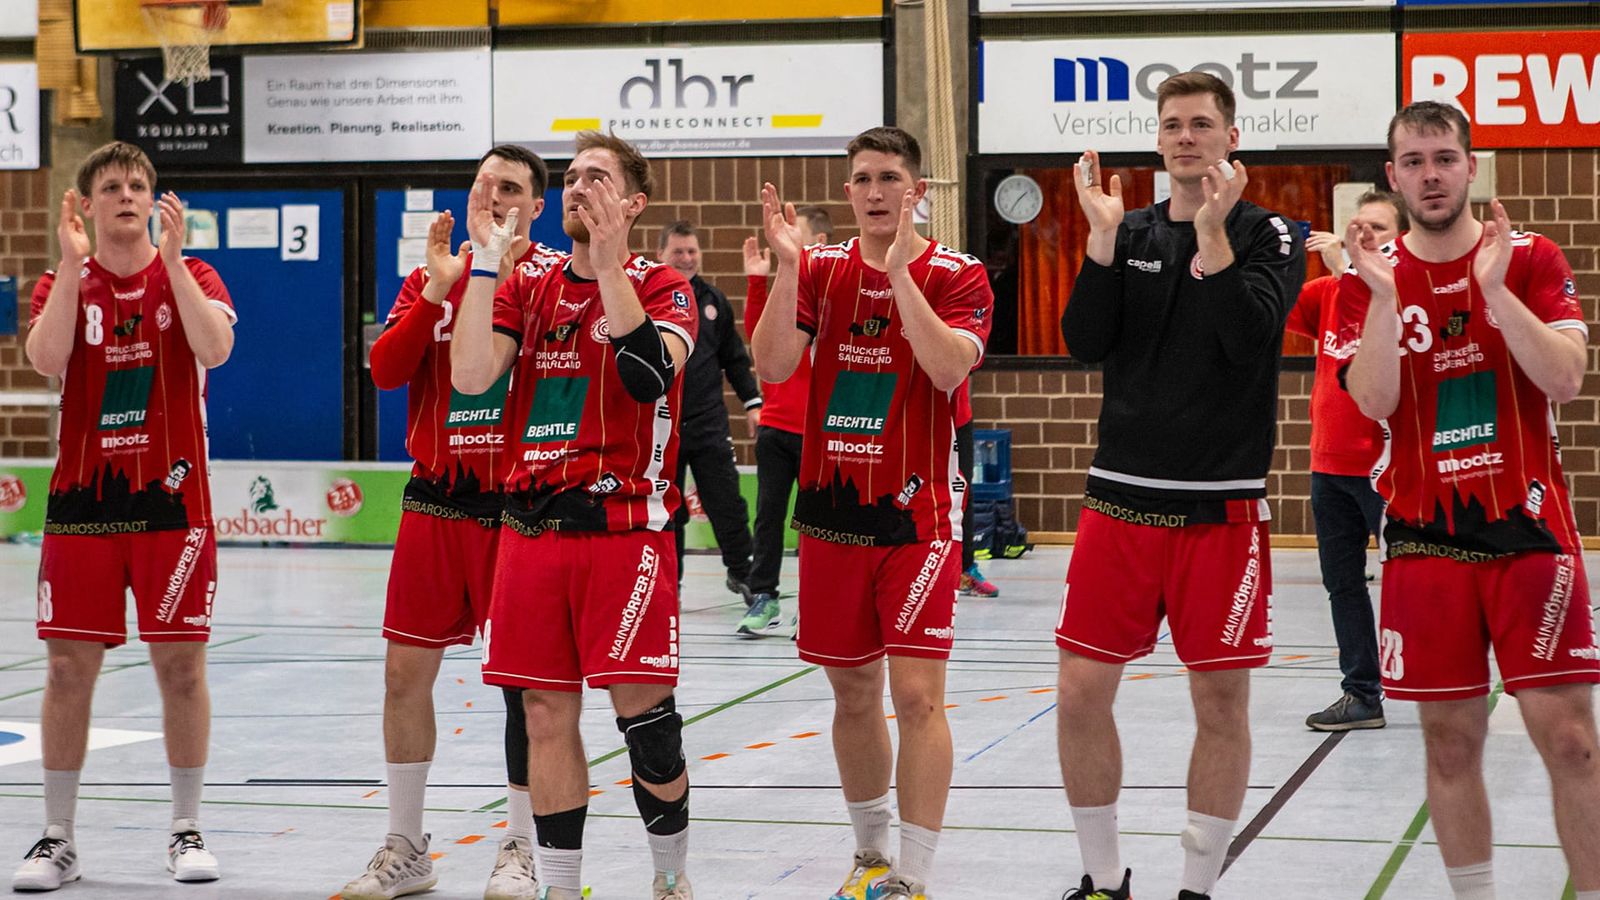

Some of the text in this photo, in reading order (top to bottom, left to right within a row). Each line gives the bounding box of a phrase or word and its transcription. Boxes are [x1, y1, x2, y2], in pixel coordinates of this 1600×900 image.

[267, 80, 286, 92] Ein
[290, 79, 324, 90] Raum
[328, 78, 346, 90] hat
[350, 78, 372, 90] drei
[620, 58, 754, 109] dbr
[267, 96, 307, 108] Genau
[310, 96, 330, 106] wie
[334, 97, 374, 106] unsere
[377, 94, 413, 106] Arbeit
[417, 94, 436, 104] mit
[268, 122, 464, 136] Kreation. Planung. Realisation.
[609, 117, 765, 128] PHONECONNECT
[1053, 108, 1319, 135] Versichemakler
[289, 226, 307, 252] 3
[86, 305, 104, 345] 8
[1397, 305, 1433, 356] 3
[839, 344, 890, 356] DRUCKEEI
[449, 408, 500, 422] BECHTLE
[827, 415, 883, 429] BECHTLE
[102, 434, 149, 448] mootz
[449, 432, 504, 446] mootz
[1433, 423, 1494, 446] BECHTLE
[524, 448, 579, 462] moot
[828, 440, 884, 454] mootz
[1438, 452, 1504, 473] mootz
[45, 520, 148, 534] BAROSSASTADT
[156, 545, 196, 622] MAINKÖRPER
[895, 552, 940, 631] MAINKÖRPER
[1219, 557, 1259, 645] MAINKÖRPER
[608, 574, 649, 659] MAINKÖRPER
[1532, 565, 1568, 660] MAINKÖRPER
[1382, 629, 1404, 680] 23
